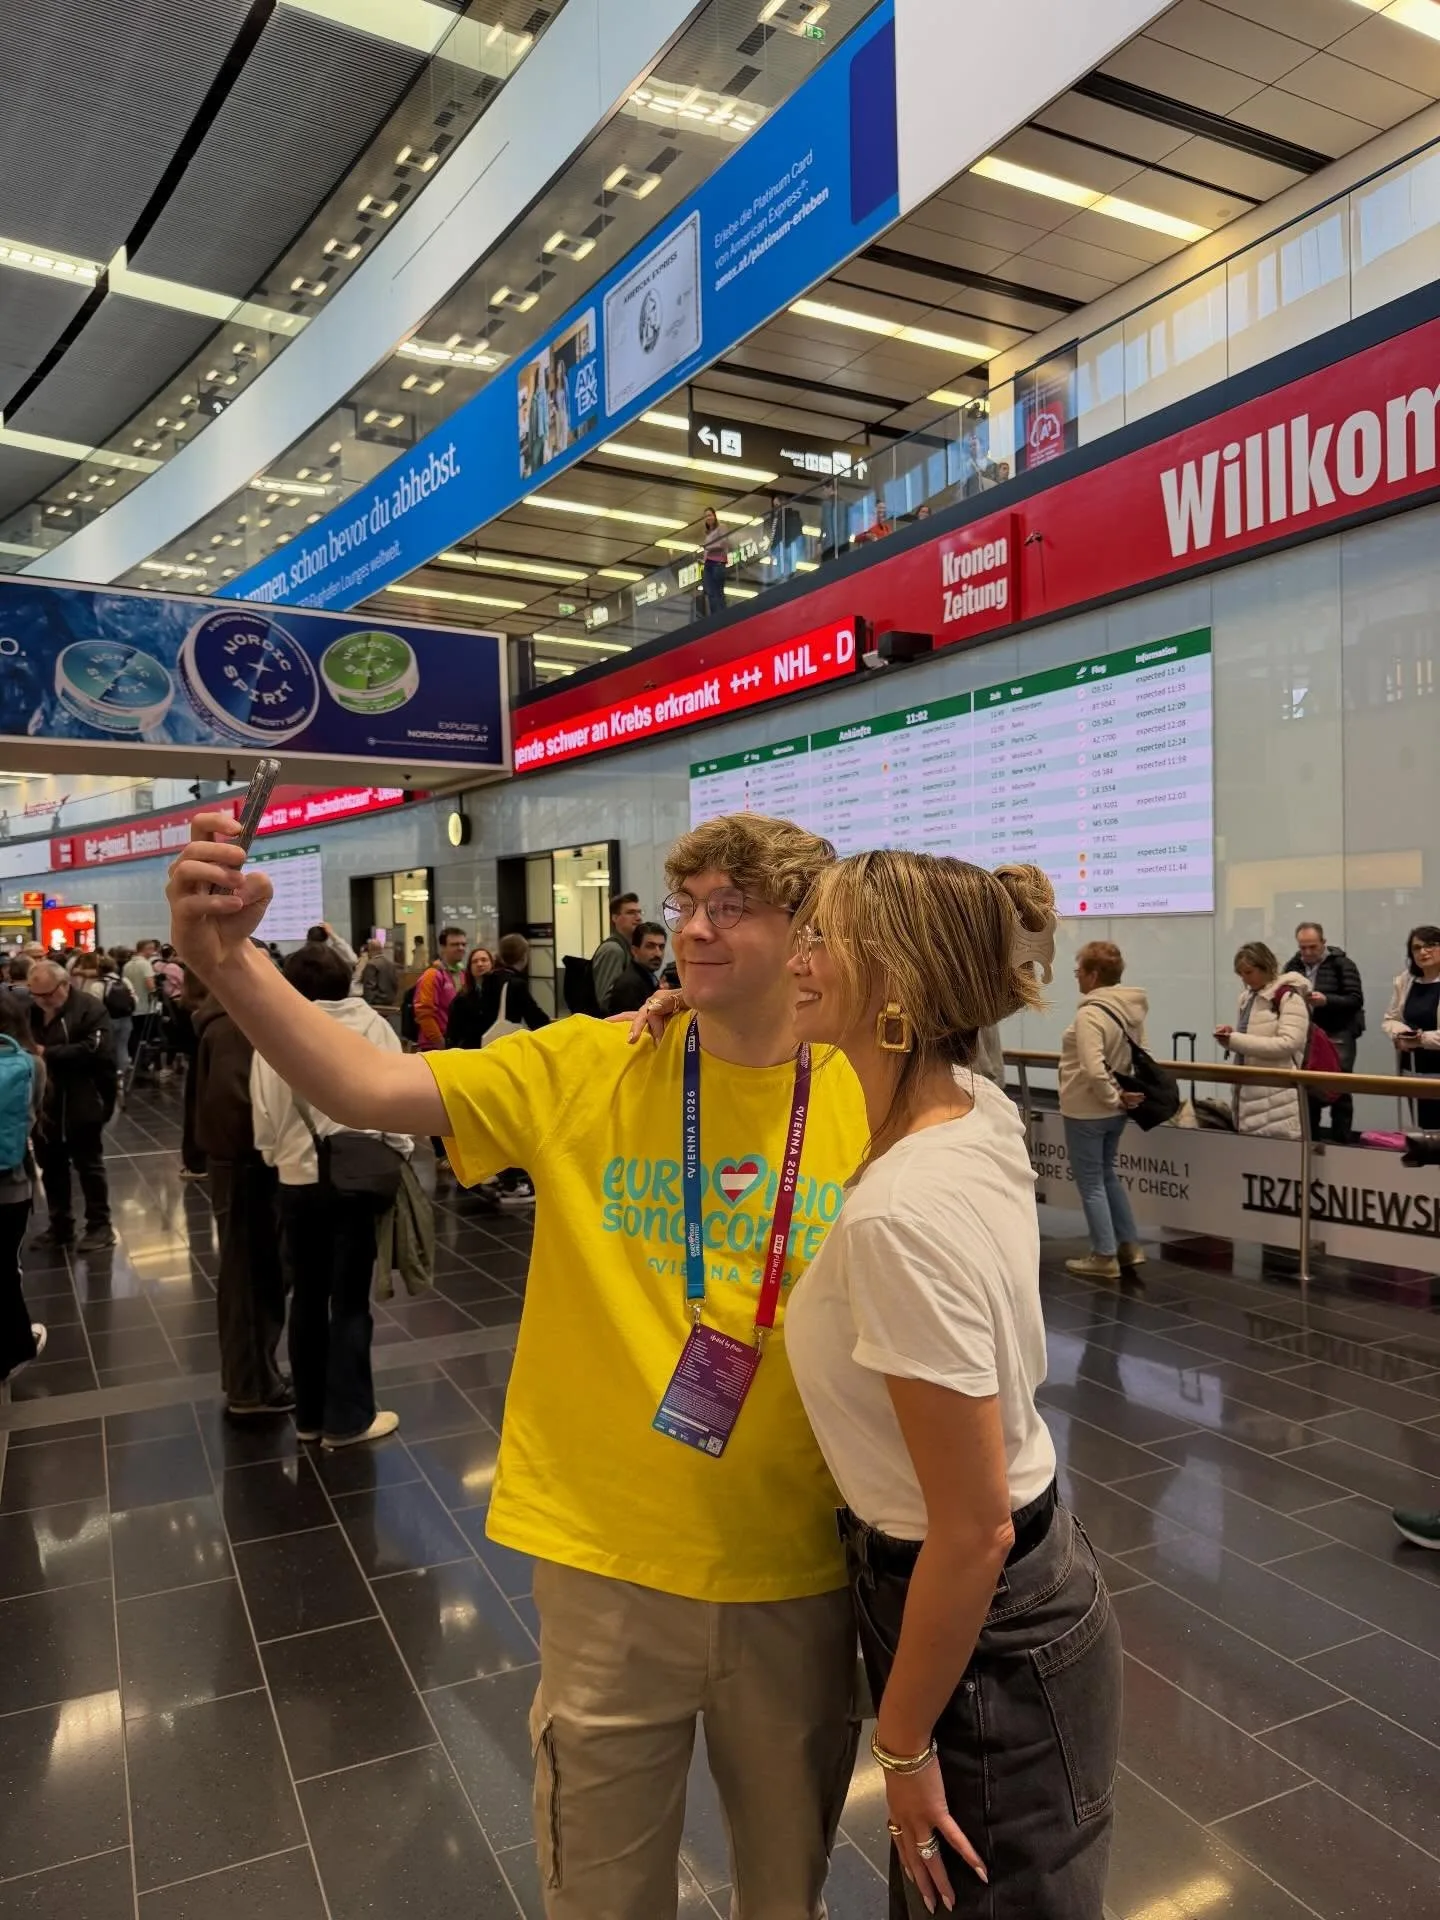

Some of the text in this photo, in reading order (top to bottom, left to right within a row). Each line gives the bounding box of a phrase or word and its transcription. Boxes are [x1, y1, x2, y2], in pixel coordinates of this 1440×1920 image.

[714, 148, 813, 249] Erlebe die Platinum Card
[714, 253, 730, 270] von
[730, 216, 767, 257] American
[1160, 384, 1440, 558] Willkom
[290, 542, 329, 589] schon
[328, 511, 369, 563] bevor
[369, 496, 391, 534] du
[391, 442, 461, 520] abhebst.
[942, 537, 1008, 587] Kronen
[942, 576, 1009, 624] Zeitung
[223, 634, 292, 672] NORDIC
[1135, 645, 1178, 663] Information
[223, 664, 294, 705] SPIRIT
[1135, 670, 1166, 684] expected
[546, 727, 590, 757] schwer
[591, 721, 609, 743] an
[610, 704, 653, 737] Krebs
[655, 678, 721, 722] erkrankt
[773, 644, 818, 686] NHL
[836, 629, 856, 665] D
[1135, 688, 1166, 702] expected
[906, 710, 929, 724] 11:02
[1135, 705, 1166, 719] expected
[438, 721, 480, 732] EXPLORE
[1136, 723, 1166, 736] expected
[407, 729, 488, 744] NORDICSPIRIT.AT
[1136, 741, 1166, 754] expected
[1136, 758, 1167, 770] expected
[1136, 794, 1167, 805] expected
[1136, 847, 1167, 857] expected
[1136, 865, 1167, 874] expected
[687, 1089, 697, 1179] VIENNA 2026
[784, 1105, 805, 1193] VIENNA 2026
[1112, 1152, 1180, 1177] ERMINAL
[1184, 1163, 1190, 1178] 1
[1138, 1178, 1190, 1201] CHECK
[774, 1235, 784, 1254] ORF
[647, 1257, 742, 1283] VIENA
[772, 1254, 781, 1268] FÜR
